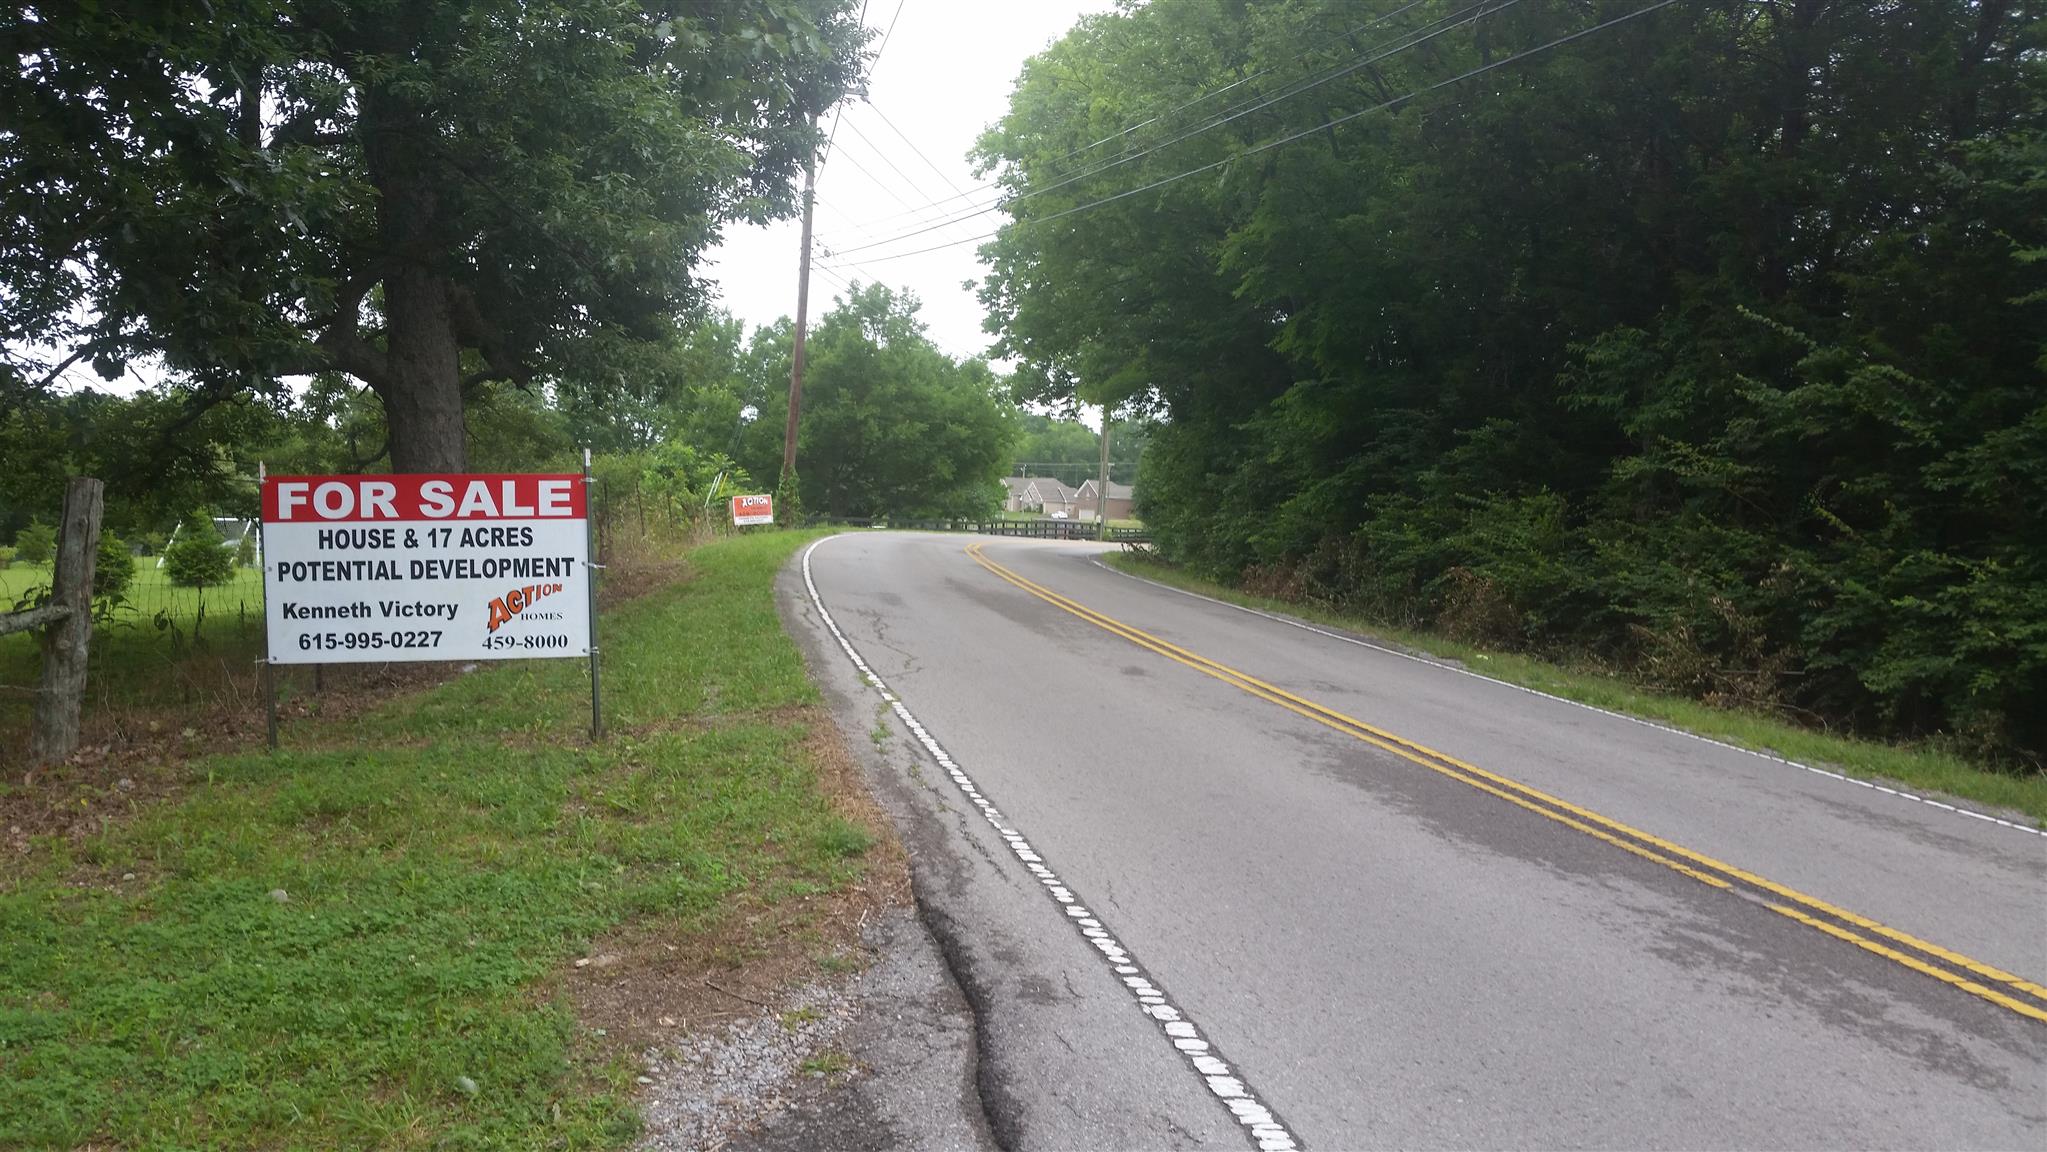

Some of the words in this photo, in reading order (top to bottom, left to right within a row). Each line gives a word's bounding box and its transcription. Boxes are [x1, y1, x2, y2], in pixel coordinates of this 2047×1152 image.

[278, 481, 399, 520] FOR
[419, 479, 573, 518] SALE
[318, 528, 396, 550] HOUSE
[403, 528, 419, 549] &
[427, 528, 453, 548] 17
[460, 526, 534, 548] ACRES
[278, 560, 403, 582] POTENTIAL
[410, 557, 575, 580] DEVELOPMENT
[282, 601, 372, 619] Kenneth
[379, 600, 459, 620] Victory
[487, 583, 563, 634] ACTION
[521, 611, 563, 621] HOMES
[298, 631, 443, 650] 615-995-0227
[482, 634, 568, 650] 459-8000
